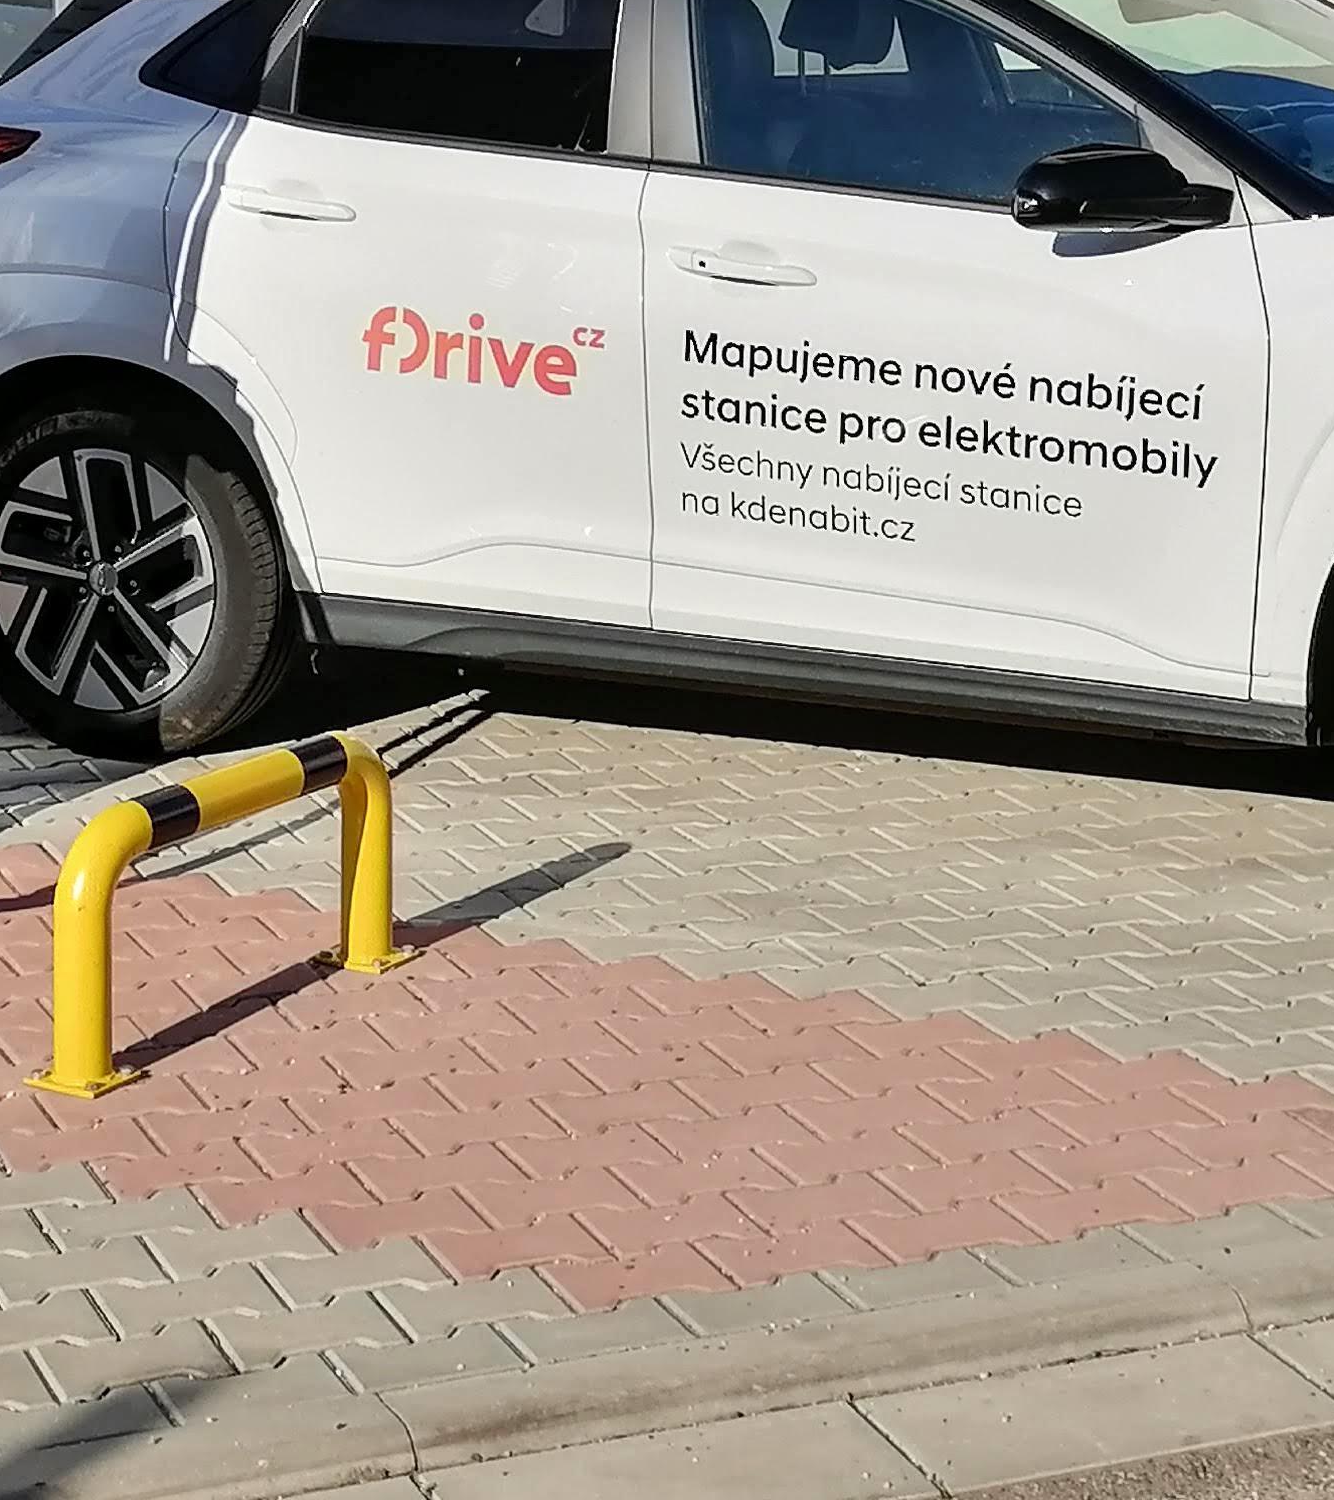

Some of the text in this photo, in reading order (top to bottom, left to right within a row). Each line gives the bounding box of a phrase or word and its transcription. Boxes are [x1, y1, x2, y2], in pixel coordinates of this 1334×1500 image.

[684, 329, 1205, 421] Mapujeme nové nabíjecí
[680, 389, 1220, 489] stanice pro elektromobily
[680, 441, 1083, 519] Všechny nabíjecí stanice
[681, 491, 917, 543] na kdenabit.cz
